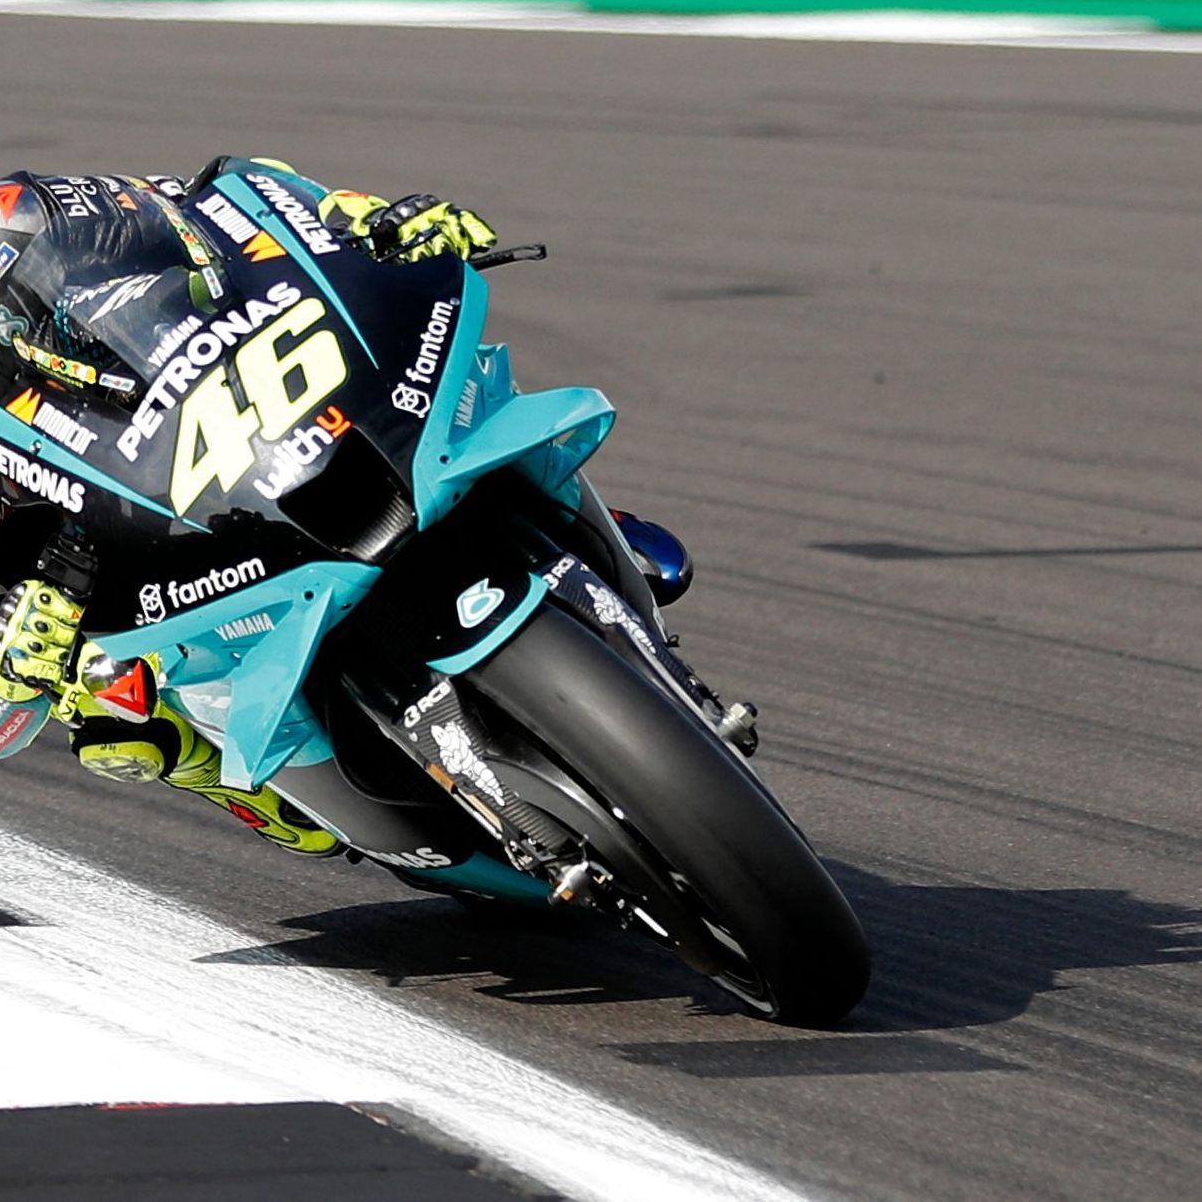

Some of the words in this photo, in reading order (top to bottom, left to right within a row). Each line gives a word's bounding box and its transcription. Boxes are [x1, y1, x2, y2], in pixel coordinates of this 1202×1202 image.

[246, 173, 341, 255] PETRONAS
[116, 281, 301, 463] PETRONAS
[148, 315, 203, 368] YAMAHA
[405, 301, 454, 384] fantom
[170, 297, 348, 517] 46
[454, 379, 478, 429] YAMAHA
[167, 557, 266, 608] fantom
[214, 613, 275, 641] YAMAHA
